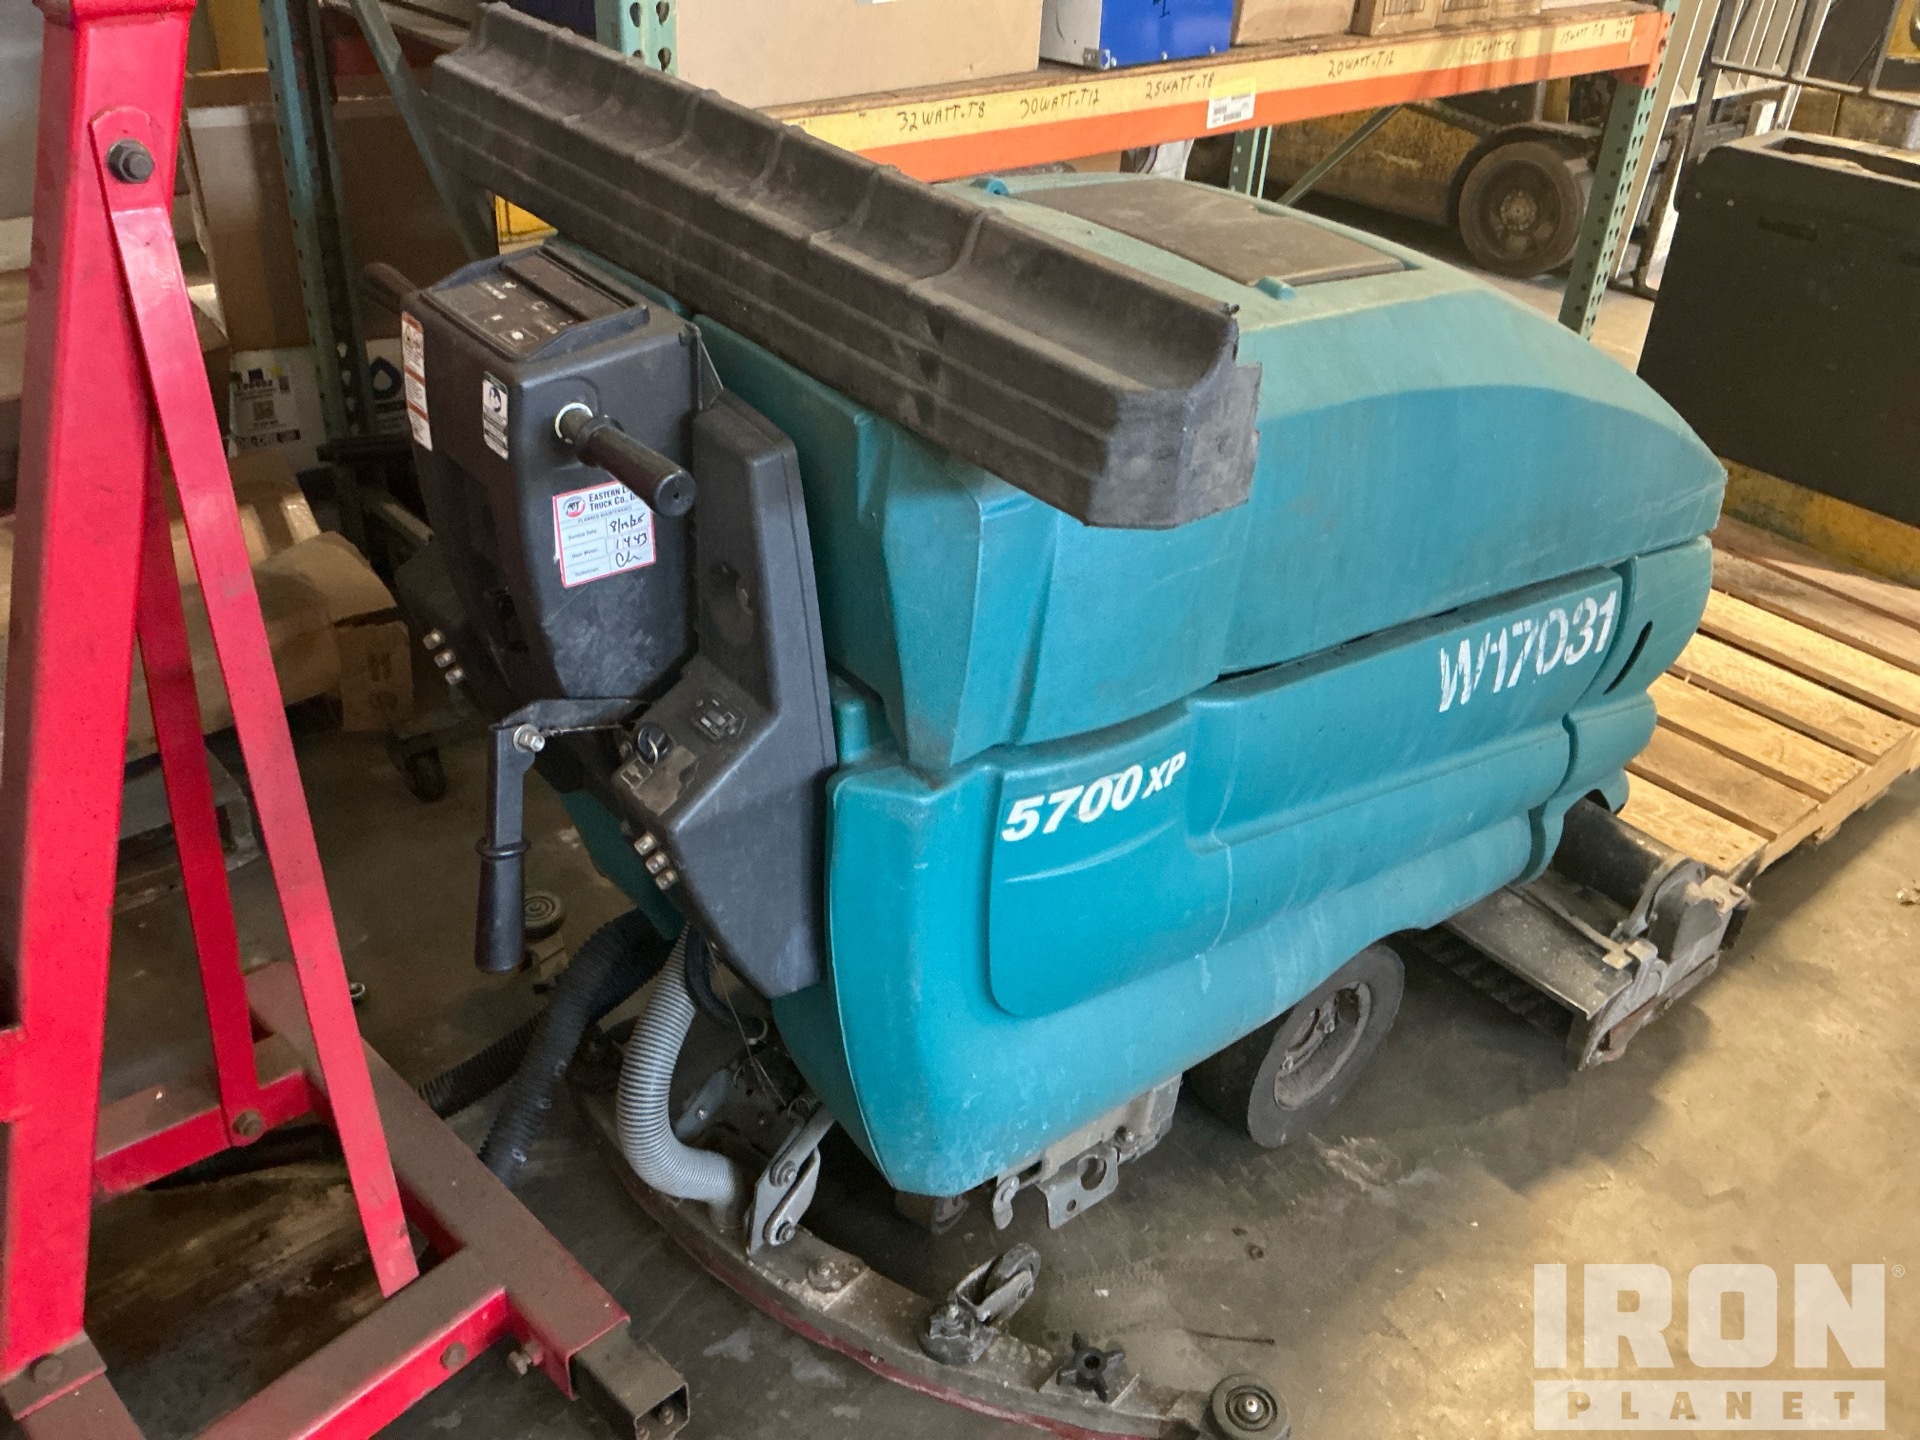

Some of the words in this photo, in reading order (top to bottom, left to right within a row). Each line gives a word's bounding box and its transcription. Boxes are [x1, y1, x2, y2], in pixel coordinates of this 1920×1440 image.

[589, 489, 620, 502] EASTERN
[589, 500, 612, 511] TRUCK
[1438, 590, 1617, 713] W17031
